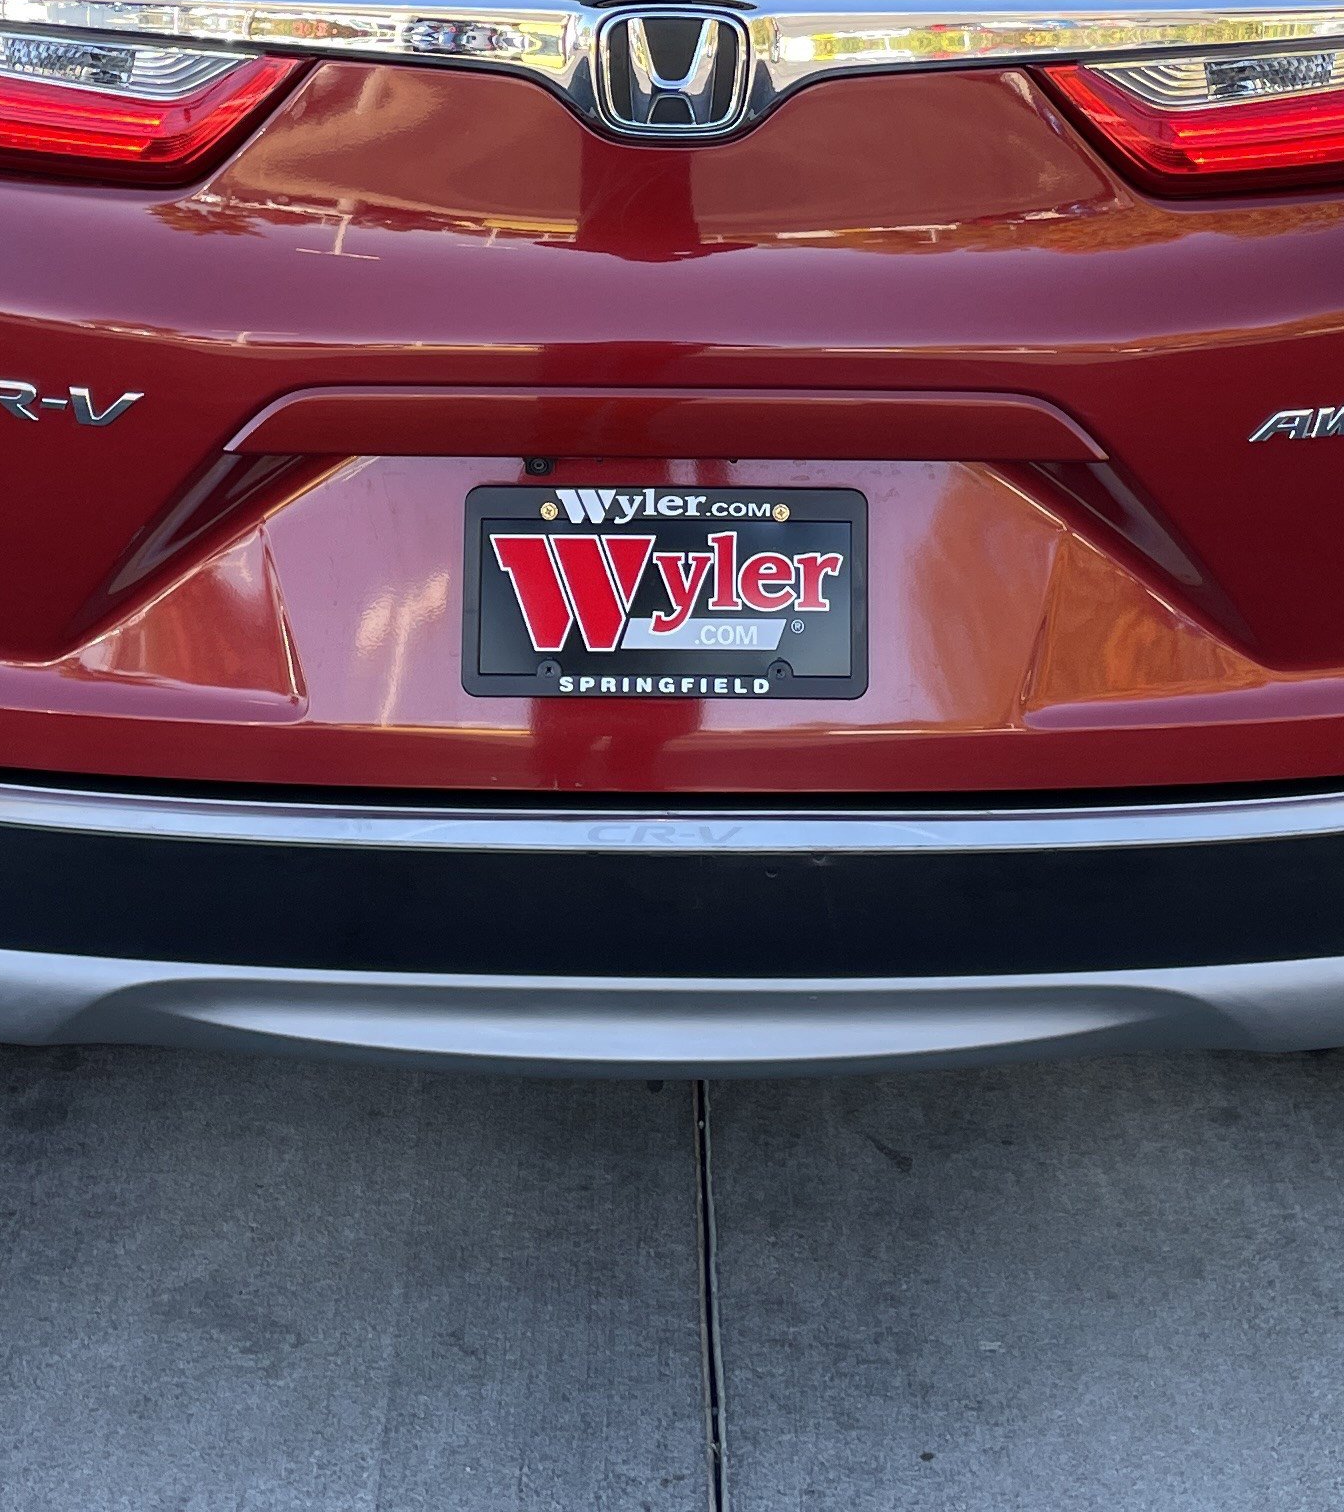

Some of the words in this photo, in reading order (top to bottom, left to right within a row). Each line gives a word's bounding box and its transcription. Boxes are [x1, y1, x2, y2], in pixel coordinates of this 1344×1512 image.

[489, 531, 844, 652] Wyler
[559, 677, 770, 694] SPRINGFIELD
[587, 825, 743, 844] CR-V
